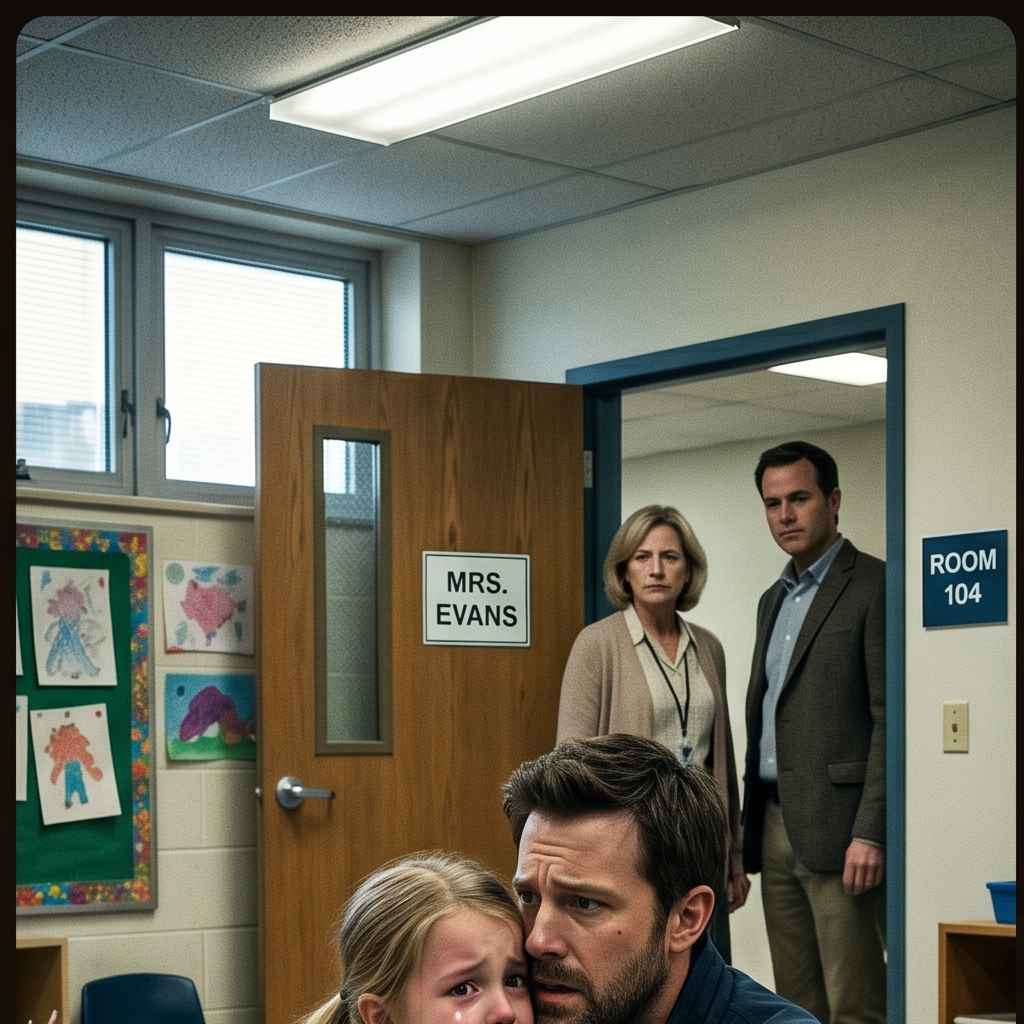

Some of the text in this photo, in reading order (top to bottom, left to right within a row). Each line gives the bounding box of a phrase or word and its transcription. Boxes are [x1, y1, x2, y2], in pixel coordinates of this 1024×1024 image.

[930, 548, 997, 575] ROOM
[447, 571, 508, 594] MRS.
[944, 582, 982, 605] 104
[436, 603, 518, 627] EVANS
